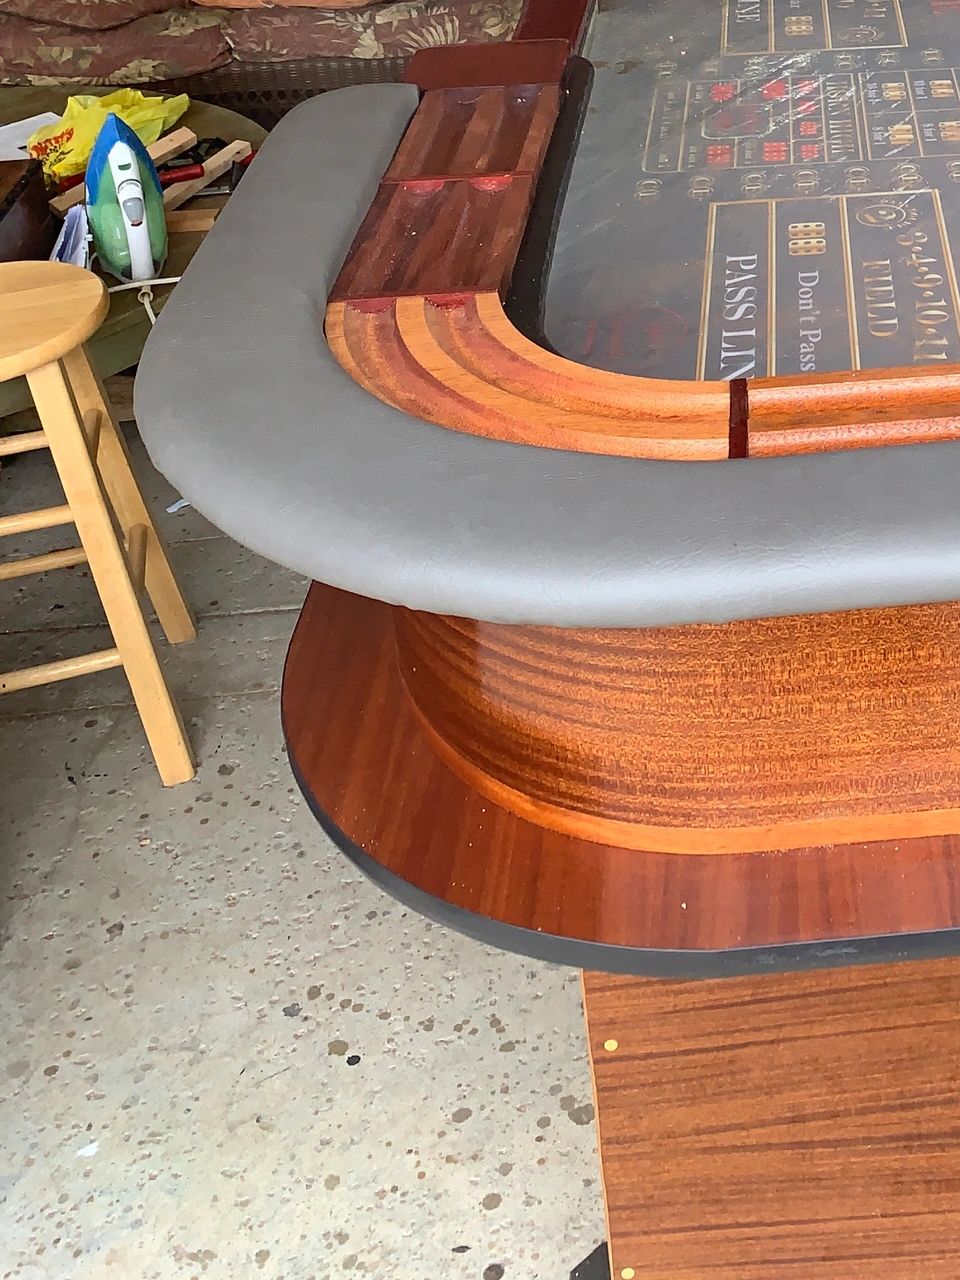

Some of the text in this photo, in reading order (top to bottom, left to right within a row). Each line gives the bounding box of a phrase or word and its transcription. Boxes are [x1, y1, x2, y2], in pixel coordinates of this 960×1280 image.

[829, 119, 855, 154] HIGH
[723, 254, 758, 321] PASS
[798, 270, 823, 372] Don't Pass
[863, 258, 899, 337] FIELD
